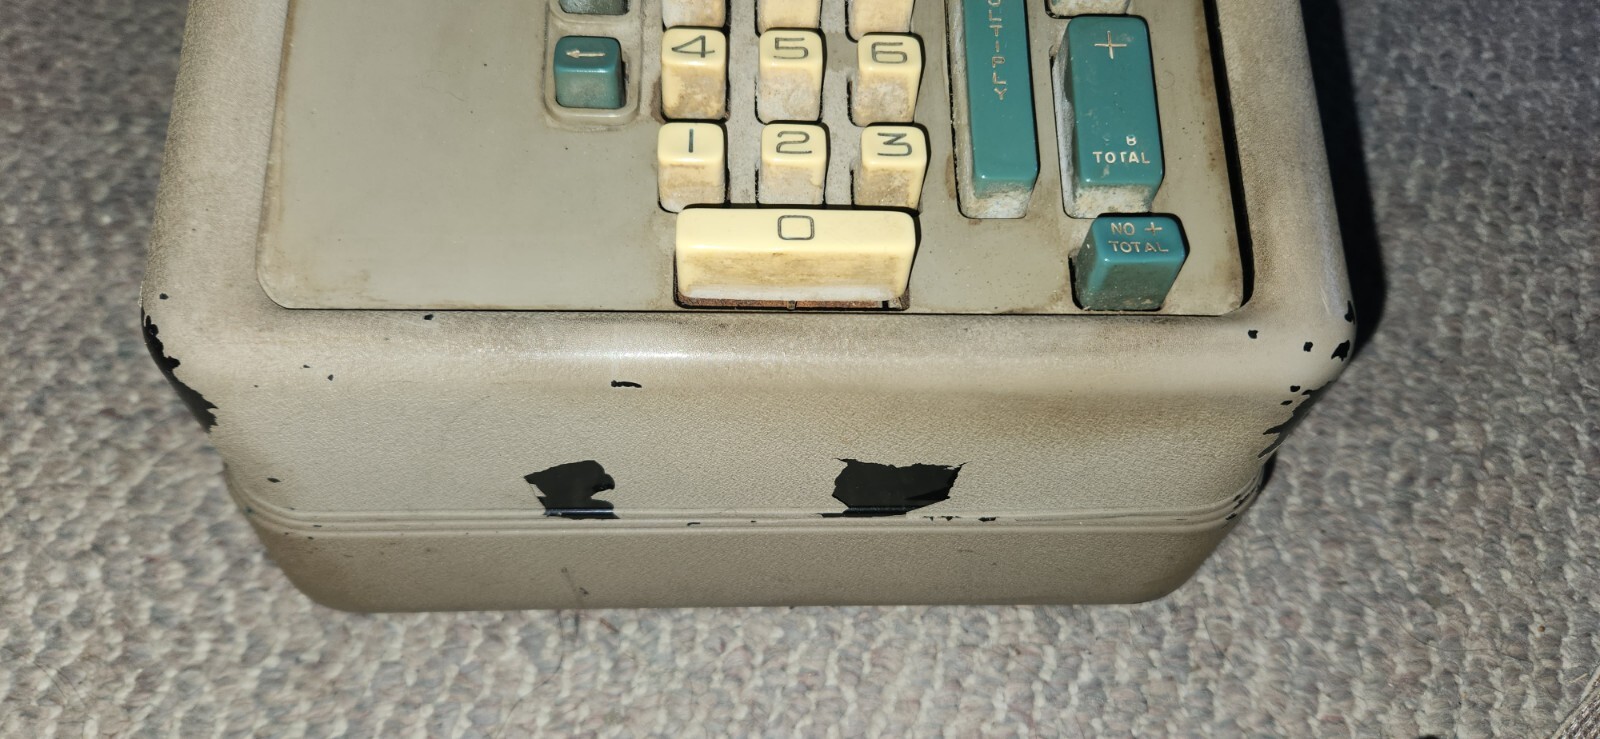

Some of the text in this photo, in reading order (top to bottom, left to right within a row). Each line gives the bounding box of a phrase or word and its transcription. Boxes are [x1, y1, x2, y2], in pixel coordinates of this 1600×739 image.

[671, 35, 715, 58] 4
[773, 37, 809, 59] 5
[871, 41, 908, 64] 6
[688, 128, 694, 153] 1
[776, 130, 812, 154] 2
[877, 132, 912, 156] 3
[1092, 151, 1150, 164] TOTAL
[1110, 222, 1135, 236] NO
[1108, 240, 1169, 253] TOTAL
